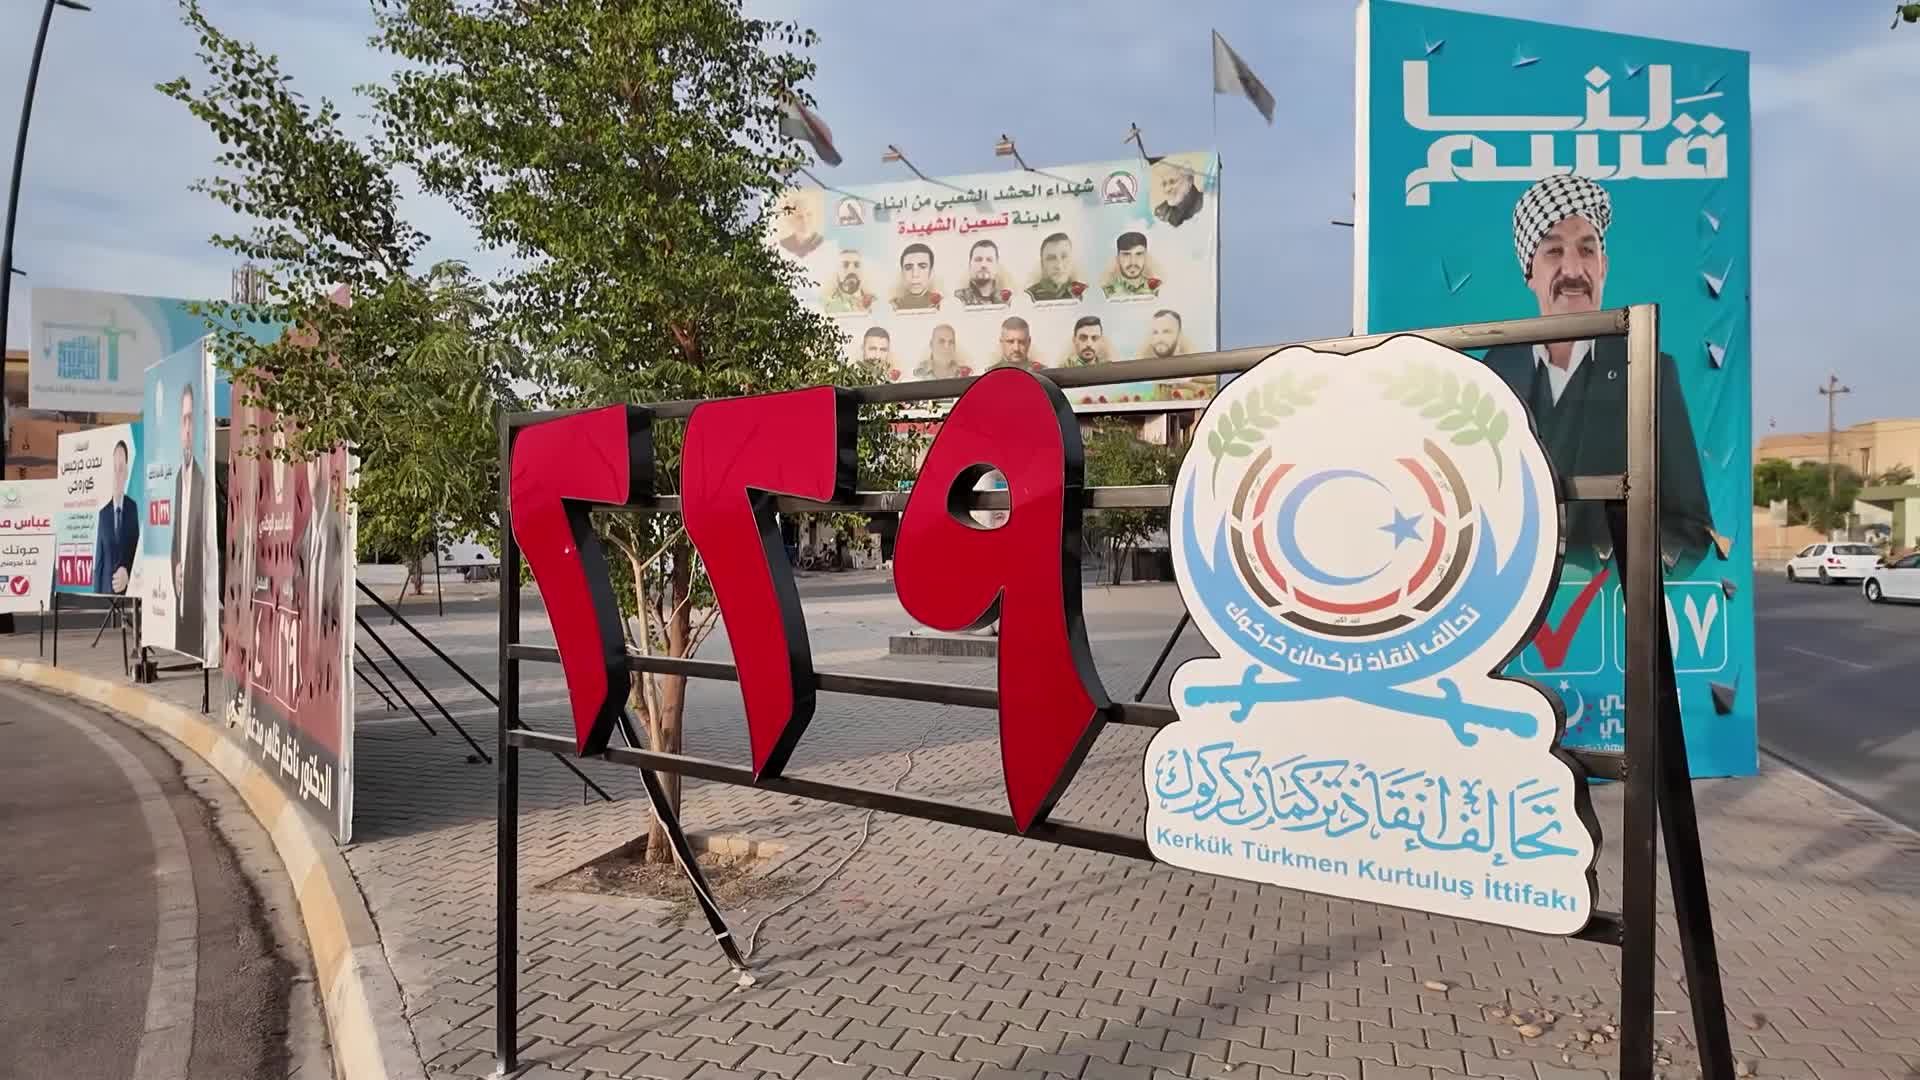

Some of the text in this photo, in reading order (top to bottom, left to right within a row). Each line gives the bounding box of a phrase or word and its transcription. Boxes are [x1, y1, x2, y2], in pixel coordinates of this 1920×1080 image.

[1403, 60, 1672, 131] لنا
[934, 188, 988, 212] الشعبي
[994, 183, 1041, 202] الحشد
[1046, 177, 1095, 198] شهداء
[911, 195, 931, 212] من
[897, 209, 1061, 237] مدينة تسعين الشهيدة
[14, 515, 50, 530] عباس
[2, 544, 39, 557] صوتك
[1225, 600, 1480, 675] تحالف انقاذ تركمان كركوك
[280, 734, 299, 779] ناظم
[299, 754, 331, 811] الدكتور
[1156, 826, 1577, 913] Kerkük Türkmen Kurtuluş İttifakı
